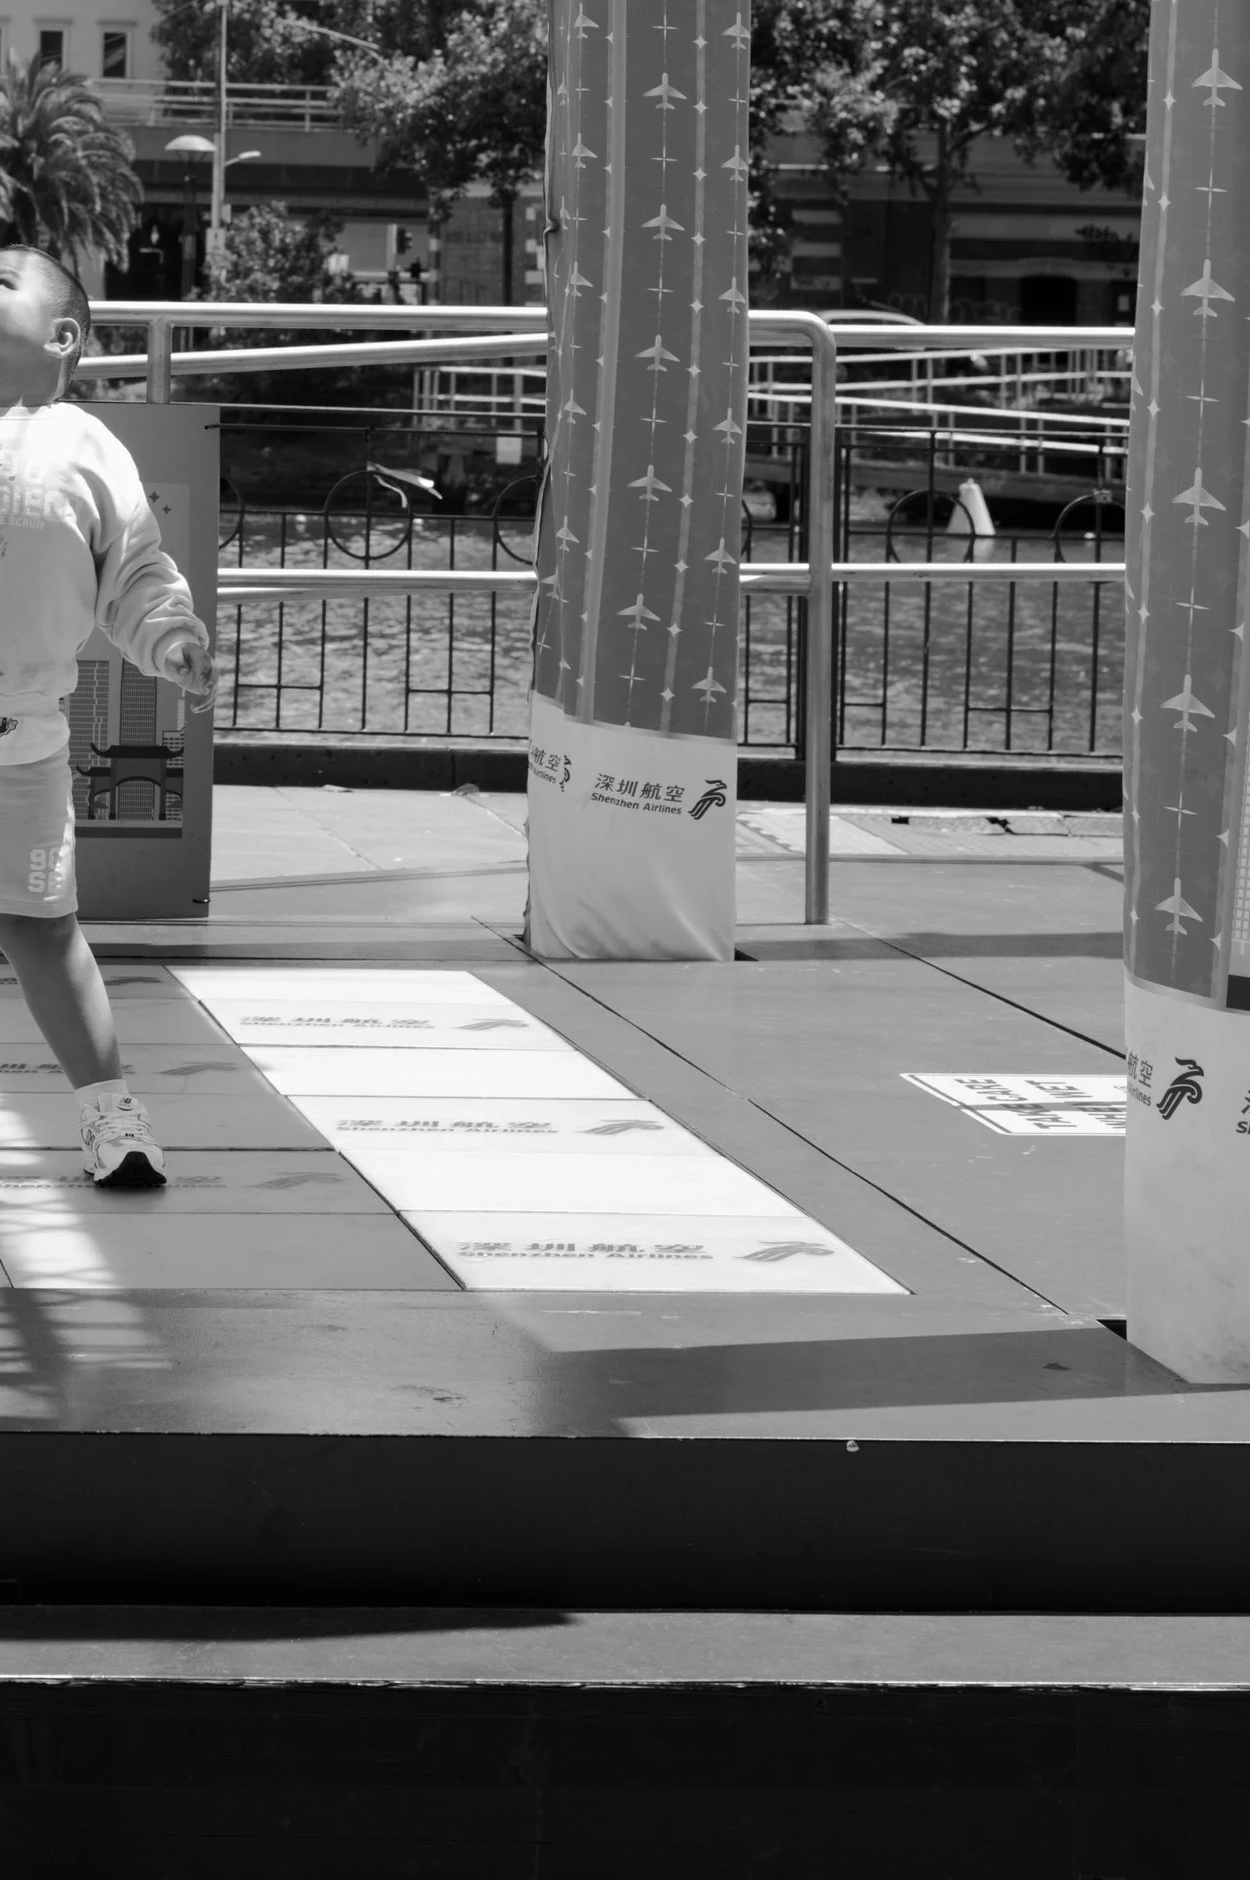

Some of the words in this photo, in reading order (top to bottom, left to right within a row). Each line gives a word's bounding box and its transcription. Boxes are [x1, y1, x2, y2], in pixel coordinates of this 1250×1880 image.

[594, 772, 686, 803] 深圳航空
[591, 792, 640, 811] Shenzhen
[642, 801, 683, 815] Airlines
[954, 1078, 1028, 1102] CARE
[1000, 1103, 1078, 1129] TAKE
